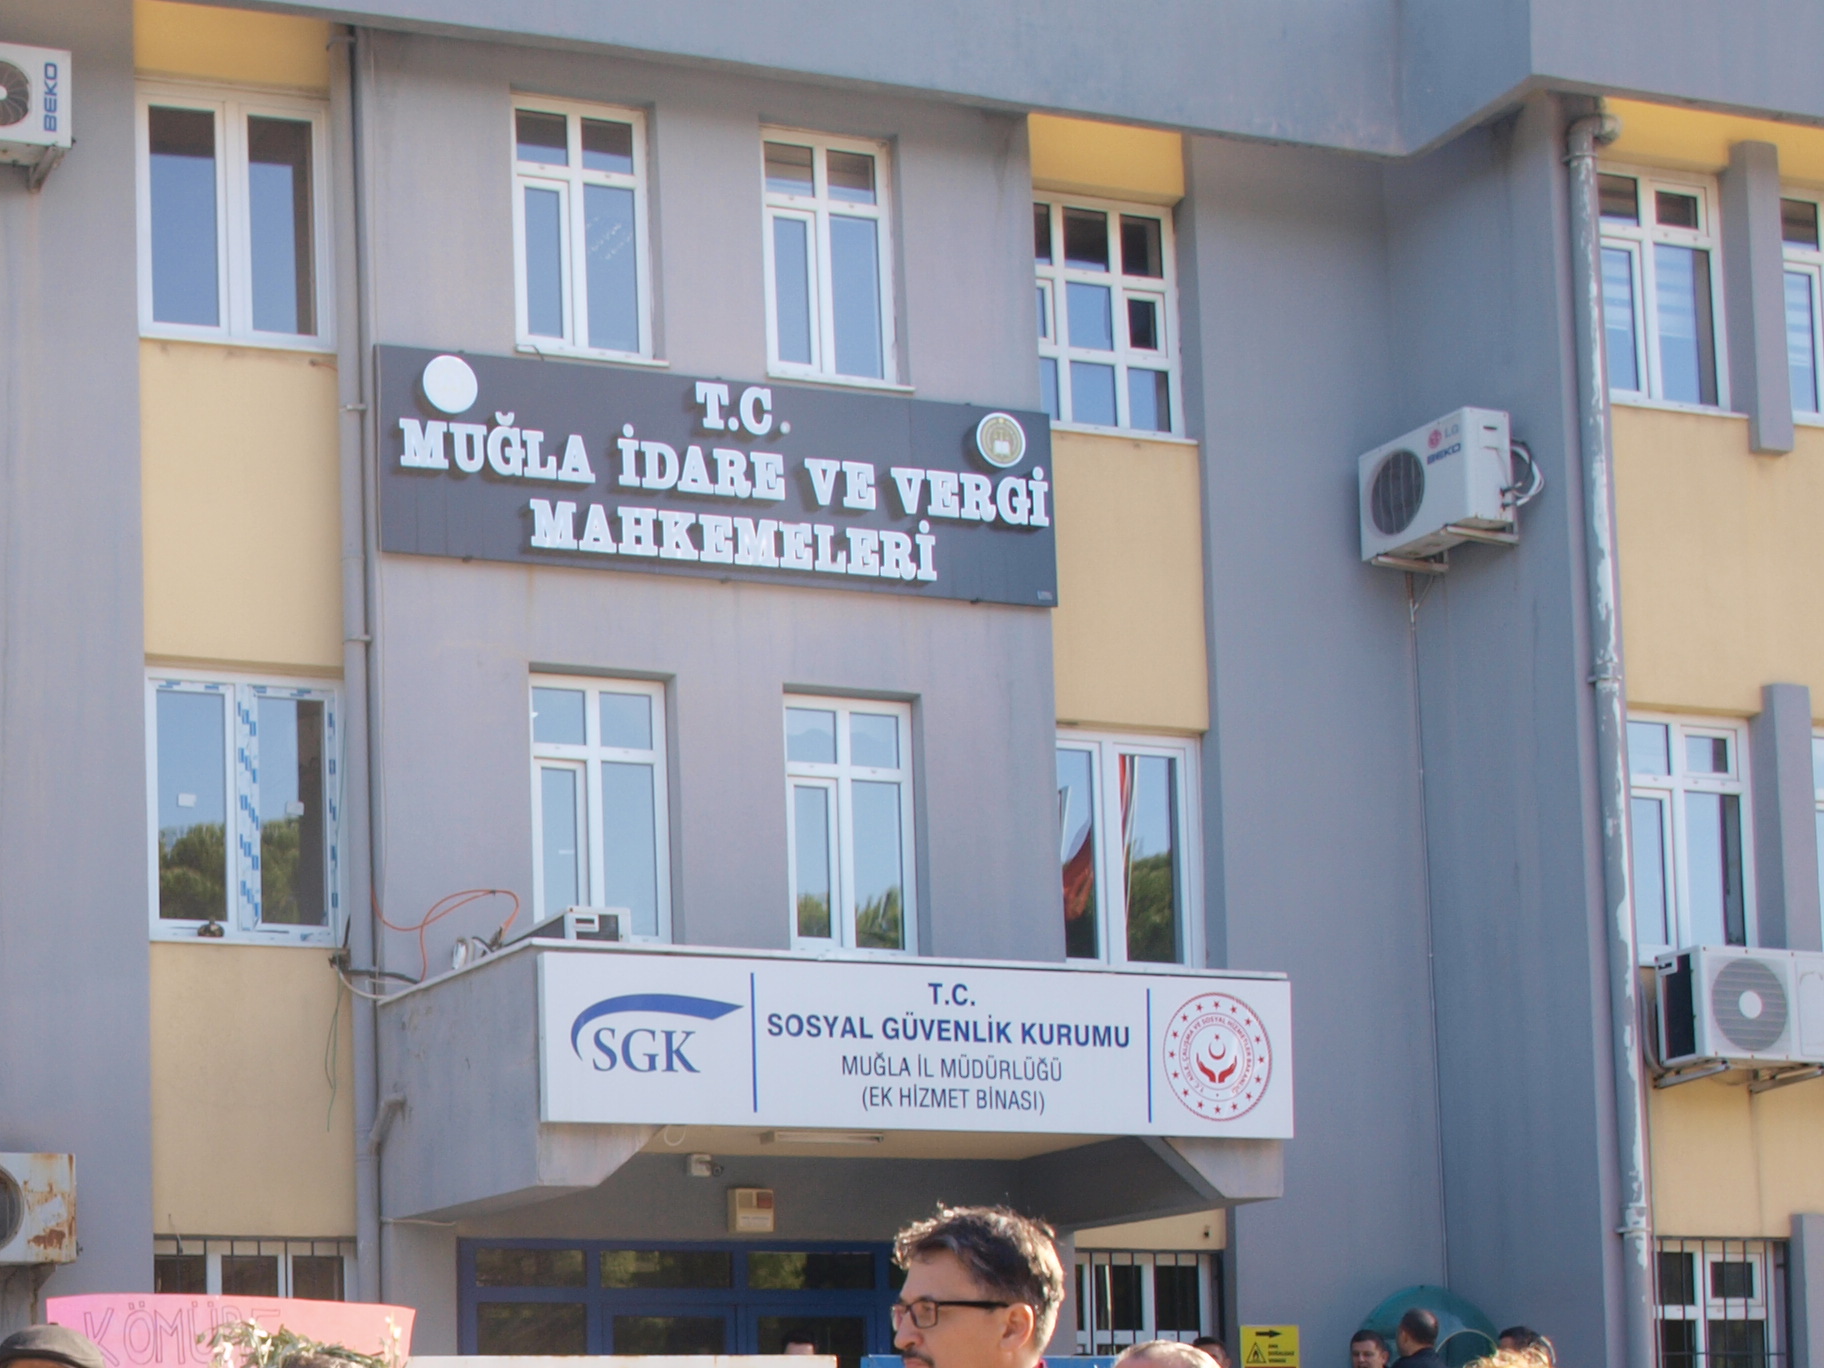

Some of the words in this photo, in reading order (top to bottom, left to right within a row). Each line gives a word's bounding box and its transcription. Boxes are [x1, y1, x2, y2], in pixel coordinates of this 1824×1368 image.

[44, 62, 58, 132] BEKO
[695, 381, 792, 435] T.C.
[399, 411, 596, 484] MUĞLA
[617, 424, 785, 501] İDARE
[805, 457, 877, 511] VE
[891, 466, 1050, 527] VERGİ
[530, 497, 938, 582] MAHKEMELERİ
[928, 982, 976, 1006] T.C.
[592, 1027, 701, 1073] SGK
[767, 1013, 874, 1038] SOSYAL
[882, 1011, 1013, 1044] GÜVENLİK
[1021, 1022, 1130, 1048] KURUMU
[841, 1051, 911, 1078] MUĞLA
[917, 1053, 935, 1078] İL
[940, 1053, 1063, 1082] MÜDÜRLÜĞÜ
[861, 1085, 893, 1112] (EK
[899, 1083, 970, 1109] HİZMET
[975, 1085, 1046, 1115] BİNASI)
